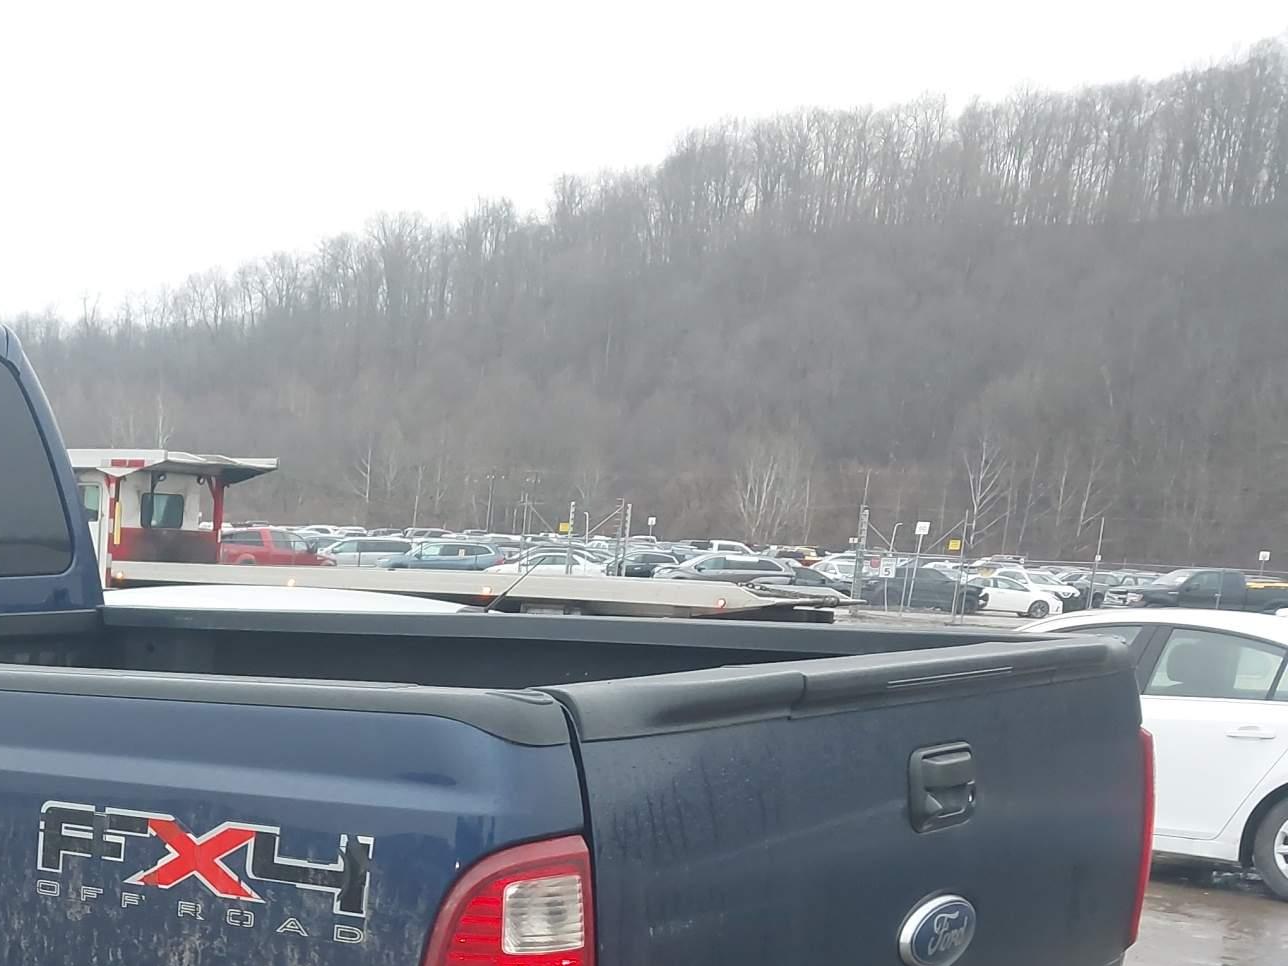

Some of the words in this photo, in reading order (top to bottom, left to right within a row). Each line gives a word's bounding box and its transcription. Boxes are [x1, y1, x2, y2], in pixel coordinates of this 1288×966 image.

[36, 800, 375, 918] FX4
[36, 879, 147, 909] OFF
[177, 900, 365, 944] ROAD
[927, 910, 968, 956] Ford
